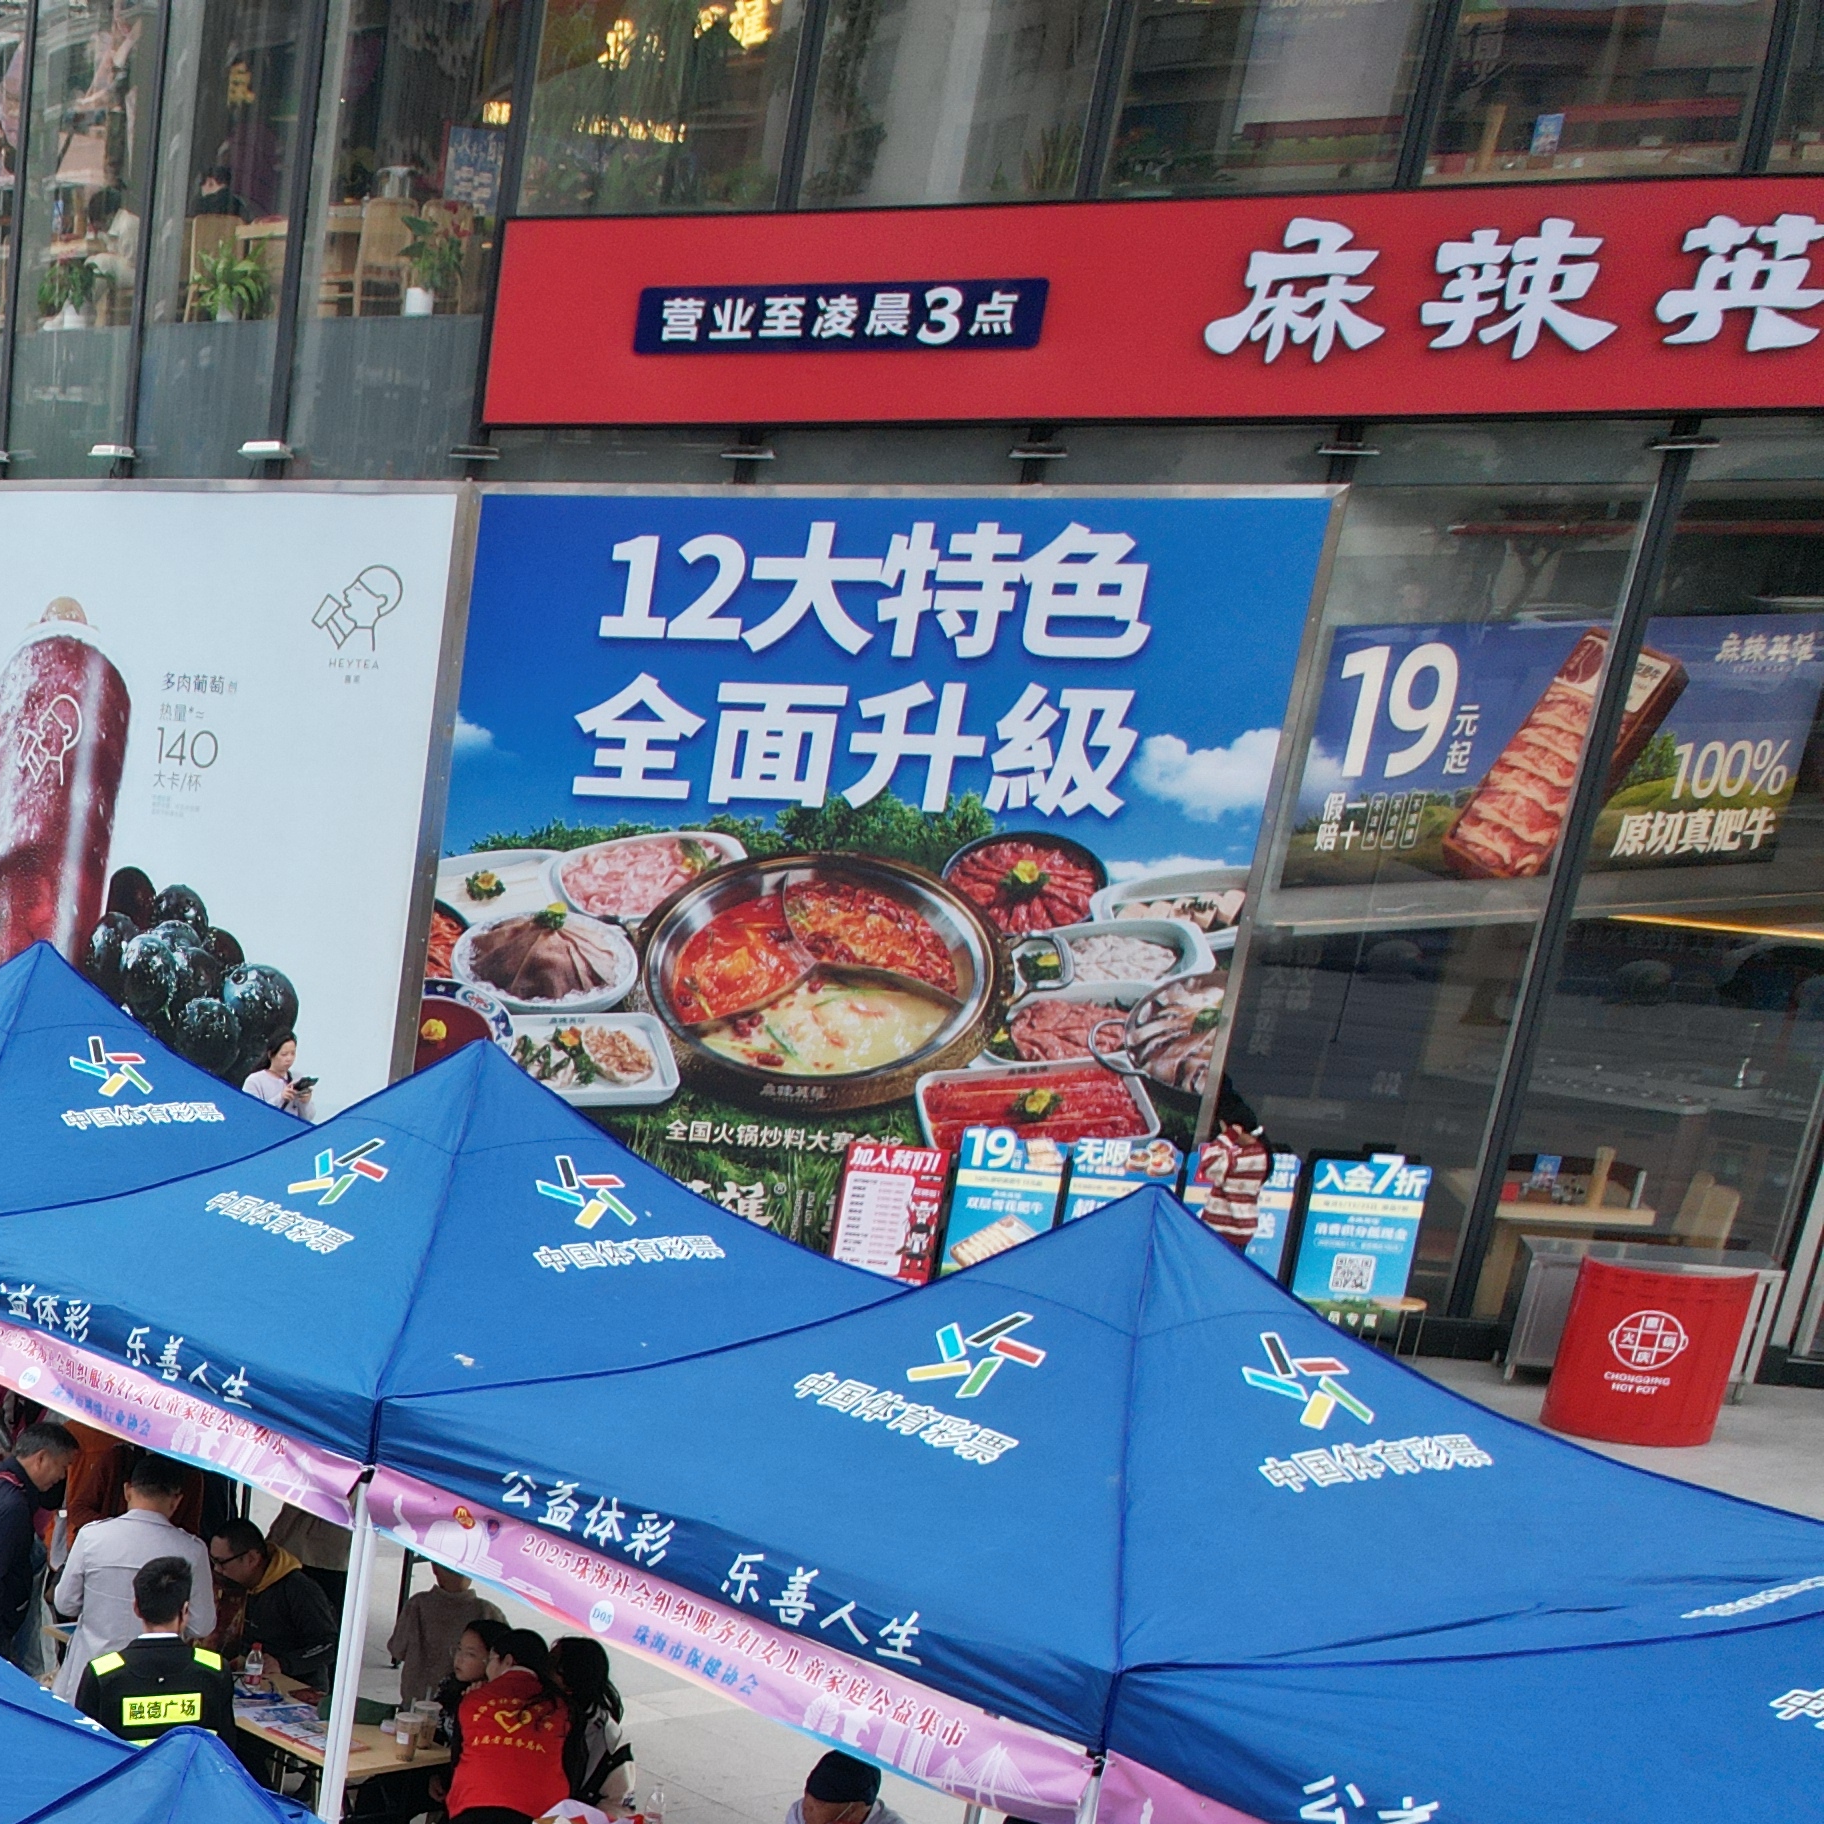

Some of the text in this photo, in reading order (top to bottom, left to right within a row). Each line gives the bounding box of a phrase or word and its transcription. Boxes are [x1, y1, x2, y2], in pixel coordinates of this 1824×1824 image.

[1204, 213, 1824, 365] 麻辣英
[660, 285, 1019, 346] 营业至凌晨3点
[598, 521, 1152, 662] 12大特色
[160, 671, 225, 695] 多肉葡萄
[328, 657, 380, 670] HEYTEA
[1341, 642, 1482, 779] 19 元起
[156, 726, 219, 769] 140
[571, 672, 1141, 820] 全面升級
[1671, 738, 1792, 801] 100%
[1321, 792, 1368, 823] 假一
[1313, 821, 1361, 852] 赔十
[1609, 806, 1779, 859] 原切真肥牛
[60, 1100, 226, 1132] 中国体育彩票
[850, 1147, 943, 1172] 加入我们!
[962, 1126, 1018, 1168] 19
[1313, 1154, 1429, 1198] 入会7折
[203, 1189, 356, 1255] 中国体育彩票
[532, 1232, 727, 1276] 中国体育彩票
[125, 1326, 253, 1409] 乐善人生
[1603, 1370, 1672, 1387] CHONGQING
[1611, 1382, 1659, 1396] HOT POT
[793, 1371, 1020, 1467] 中国体育彩票
[1258, 1433, 1494, 1497] 中国体育彩票
[500, 1469, 927, 1668] 公益体彩 乐善人生
[591, 1606, 615, 1627] D05
[520, 1532, 967, 1750] 2025珠海社会组织服务妇女儿童家庭公益集市
[631, 1622, 762, 1698] 珠海市保健协会
[128, 1697, 200, 1722] 融德广场
